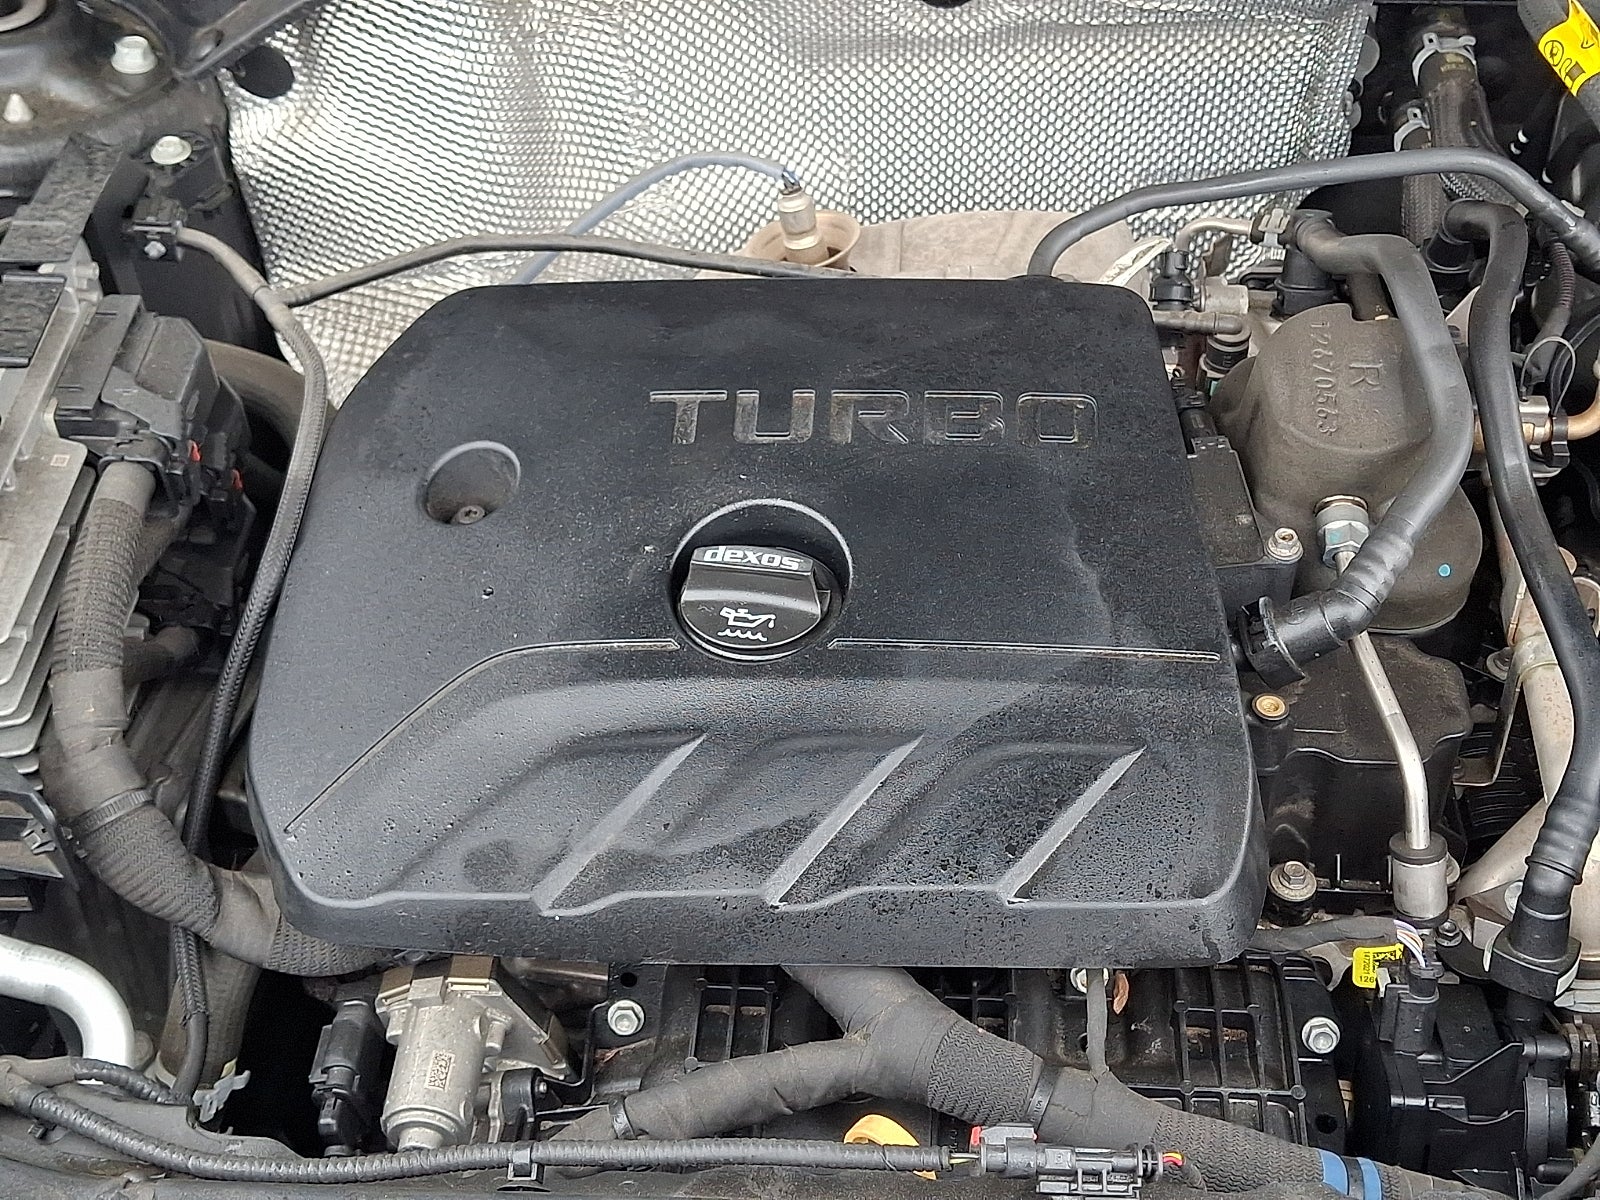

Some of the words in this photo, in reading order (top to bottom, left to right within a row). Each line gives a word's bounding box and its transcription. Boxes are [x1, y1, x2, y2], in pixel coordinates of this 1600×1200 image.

[649, 388, 1099, 448] TURBO
[703, 545, 804, 571] dexos
[1358, 975, 1377, 984] 126
